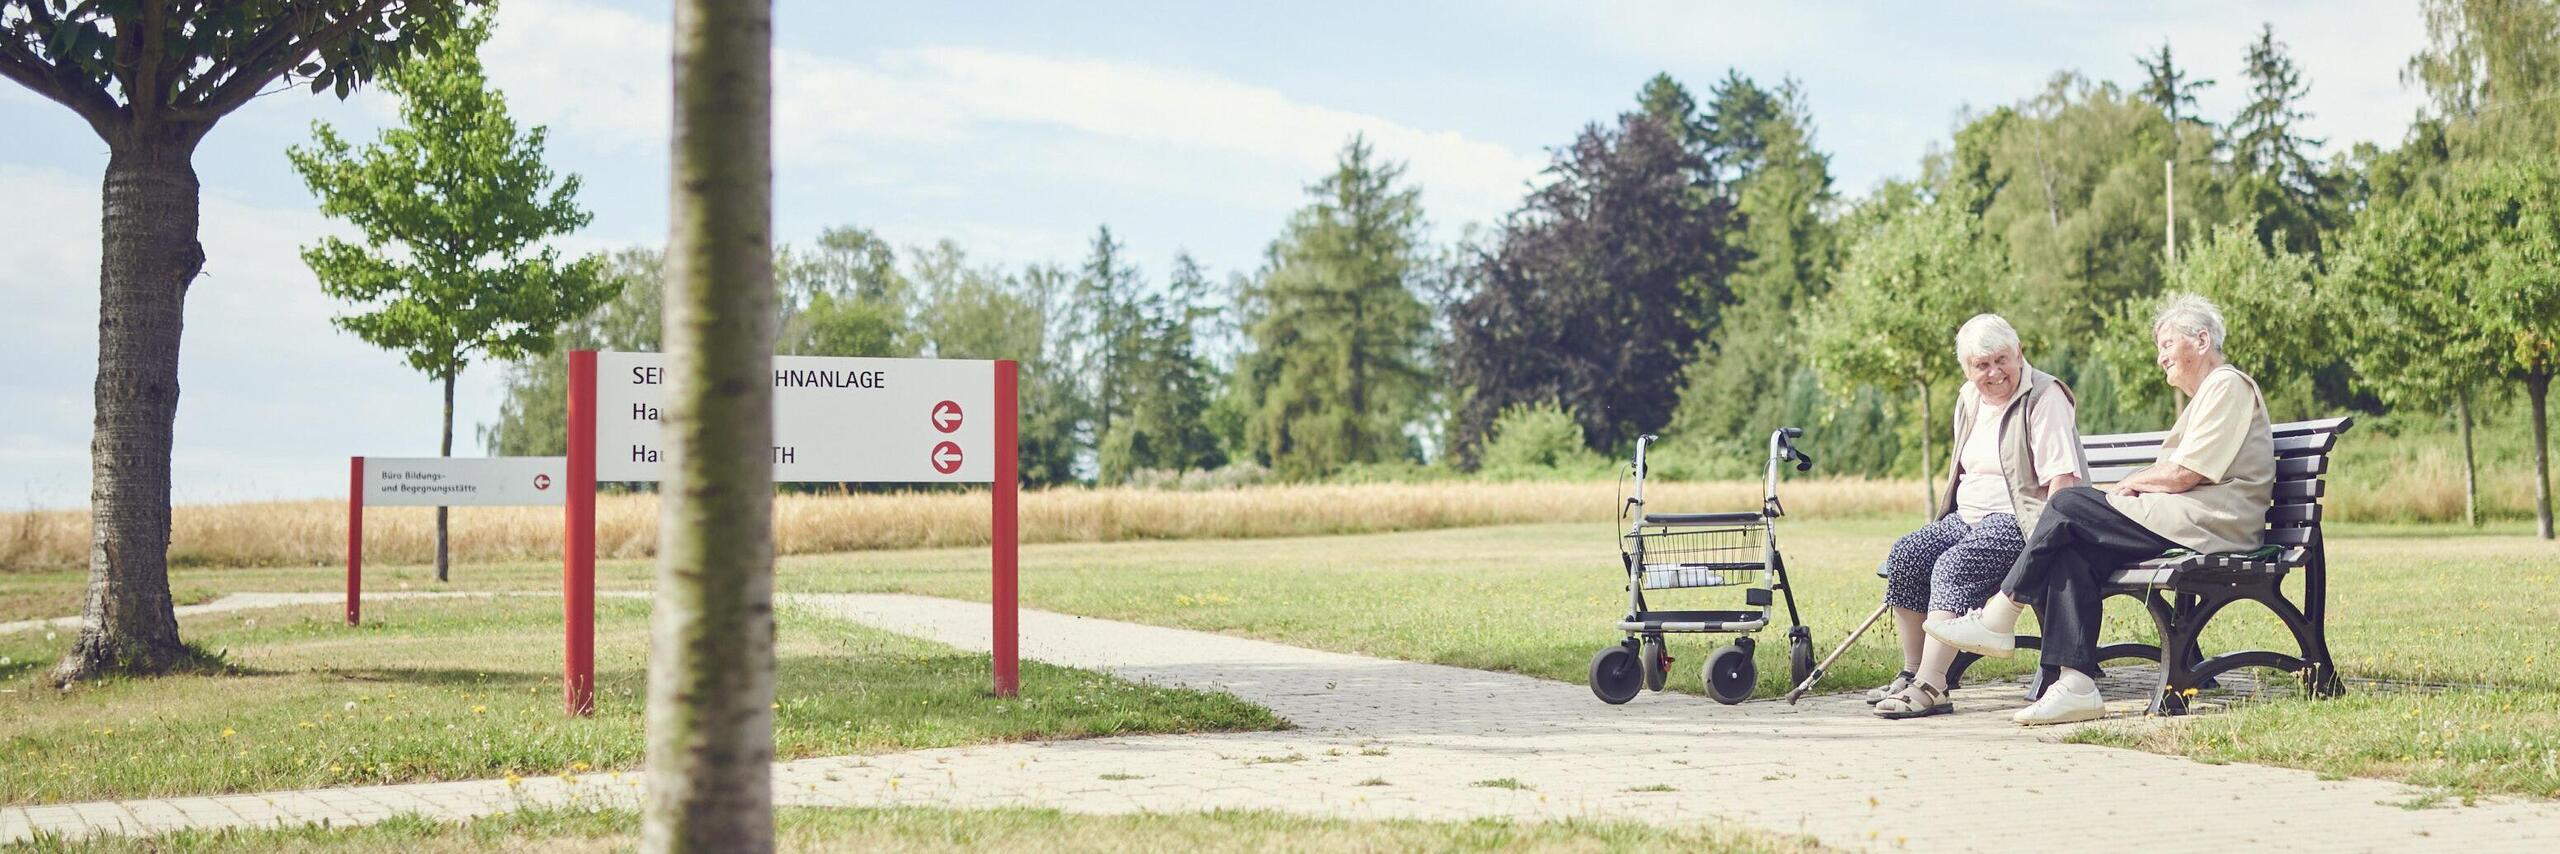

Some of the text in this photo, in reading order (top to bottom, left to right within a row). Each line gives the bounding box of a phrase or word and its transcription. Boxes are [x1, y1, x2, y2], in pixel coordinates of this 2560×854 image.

[381, 470, 446, 482] Büro Bildungs-
[381, 483, 478, 495] und Begegnungsstätte
